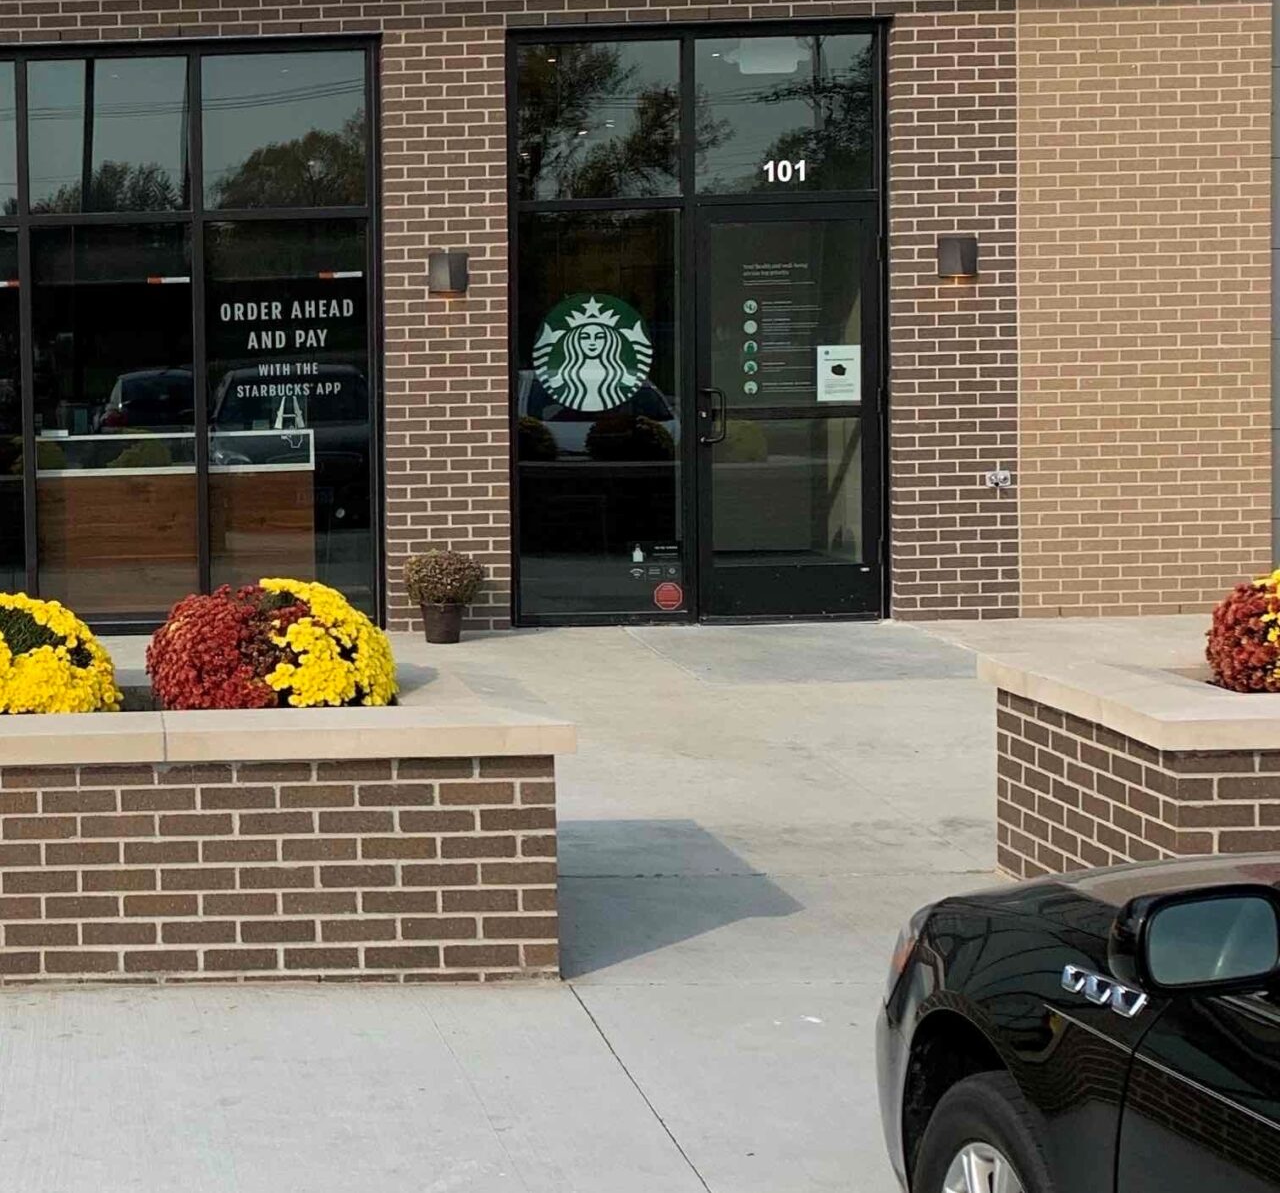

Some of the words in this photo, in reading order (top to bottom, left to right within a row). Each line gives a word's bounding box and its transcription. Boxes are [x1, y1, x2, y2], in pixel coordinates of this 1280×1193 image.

[763, 160, 805, 182] 101
[220, 301, 282, 321] ORDER
[291, 299, 354, 319] AHEAD
[247, 330, 286, 350] AND
[295, 328, 328, 348] PAY
[258, 363, 291, 376] WITH
[295, 362, 319, 375] THE
[316, 382, 342, 395] APP
